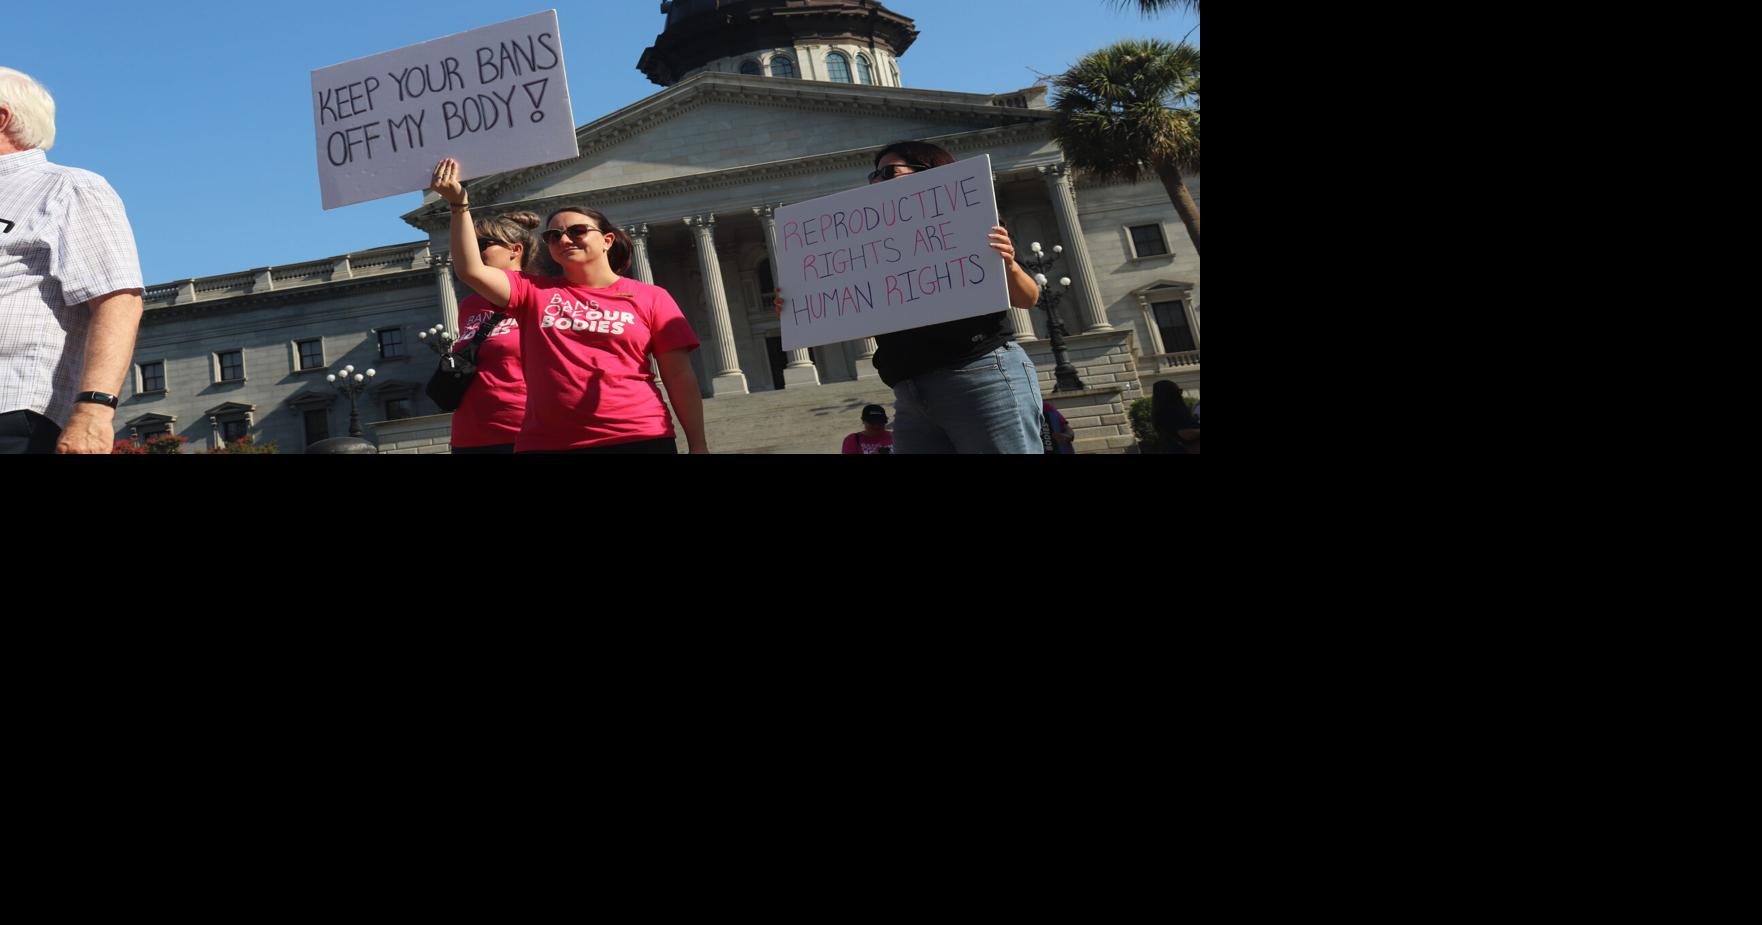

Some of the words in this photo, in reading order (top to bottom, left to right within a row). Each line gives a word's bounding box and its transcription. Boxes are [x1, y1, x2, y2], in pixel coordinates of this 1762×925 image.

[318, 77, 380, 125] KEEP
[388, 57, 464, 102] YOUR
[476, 33, 559, 85] BANS
[327, 121, 381, 167] OFF
[387, 109, 425, 153] MY
[442, 77, 549, 141] BODY!
[783, 176, 981, 251] REPRODUCTIVE
[803, 237, 901, 281] RIGHTS
[913, 221, 958, 256] ARE
[550, 293, 600, 312] BANS
[585, 310, 635, 325] OUR
[792, 282, 874, 326] HUMAN
[885, 254, 985, 305] RIGHTS
[540, 315, 625, 335] BODIES
